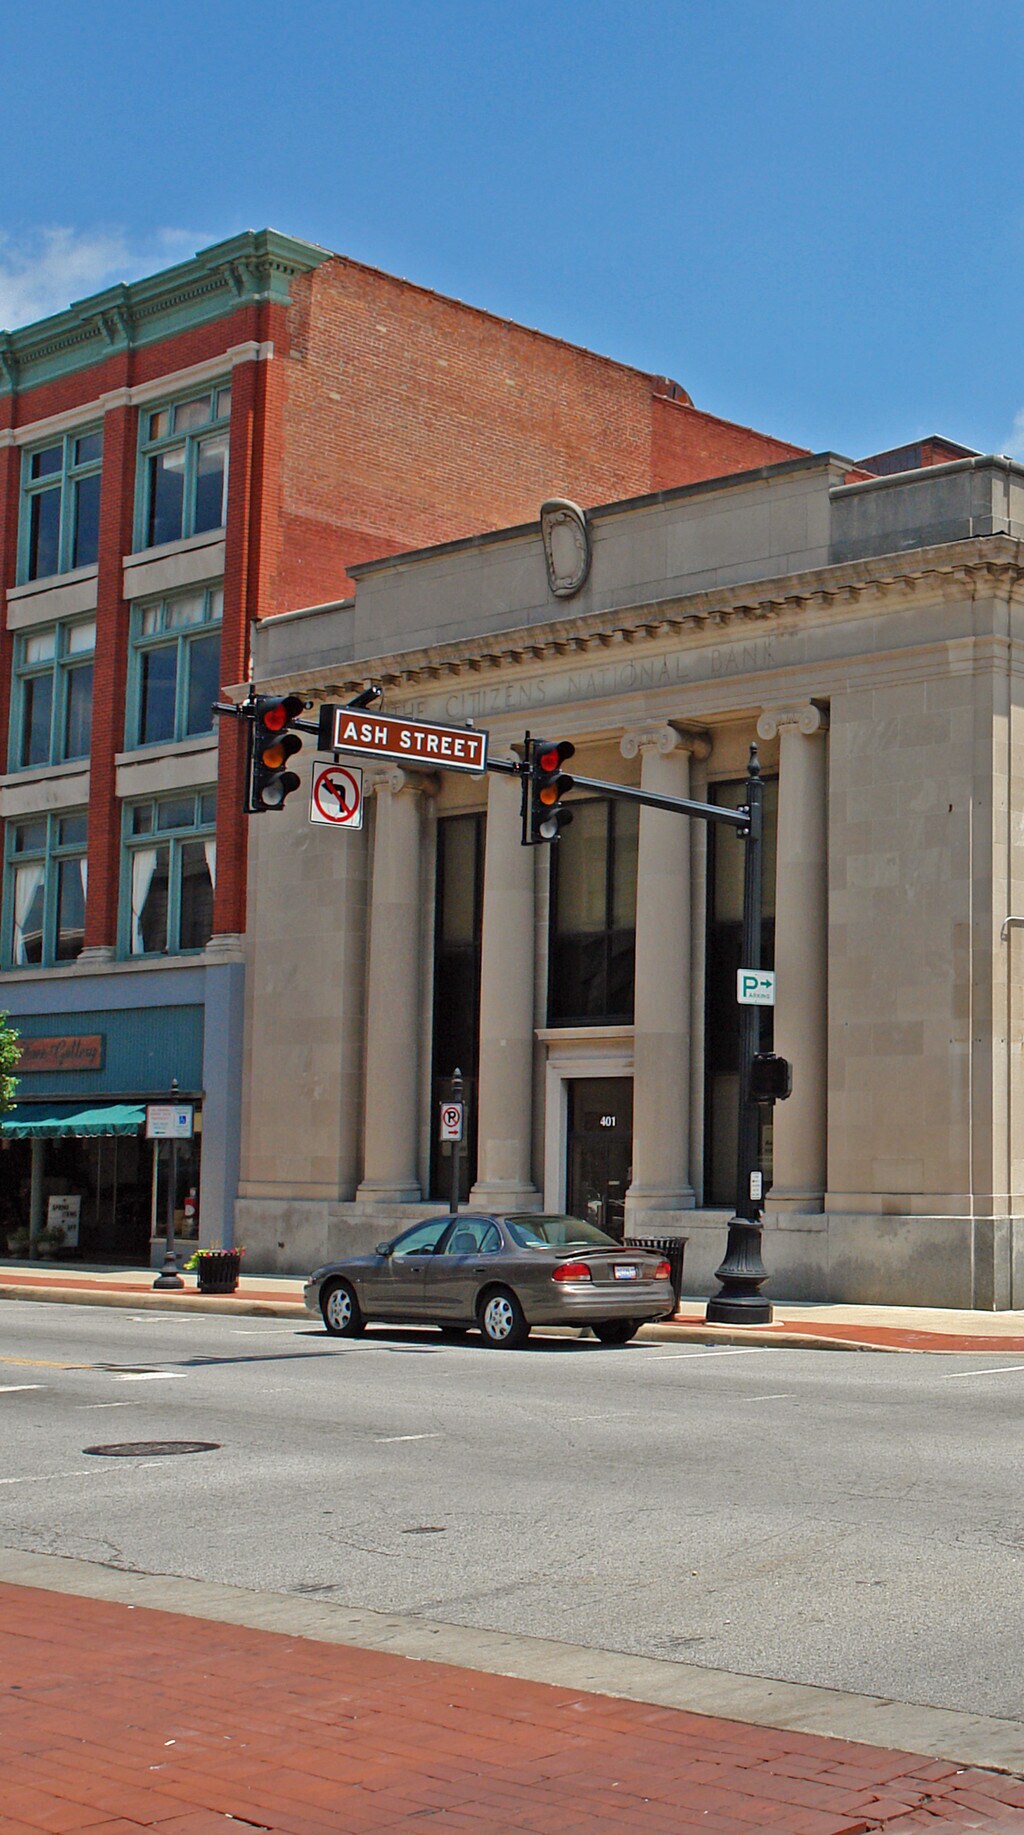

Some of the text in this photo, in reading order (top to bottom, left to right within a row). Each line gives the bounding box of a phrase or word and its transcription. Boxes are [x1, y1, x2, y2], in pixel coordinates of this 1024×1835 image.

[446, 677, 547, 718] CITIZENS
[568, 655, 689, 694] NATIONAL
[711, 639, 776, 673] BANK
[343, 721, 479, 758] ASH STREET
[600, 1116, 615, 1127] 401
